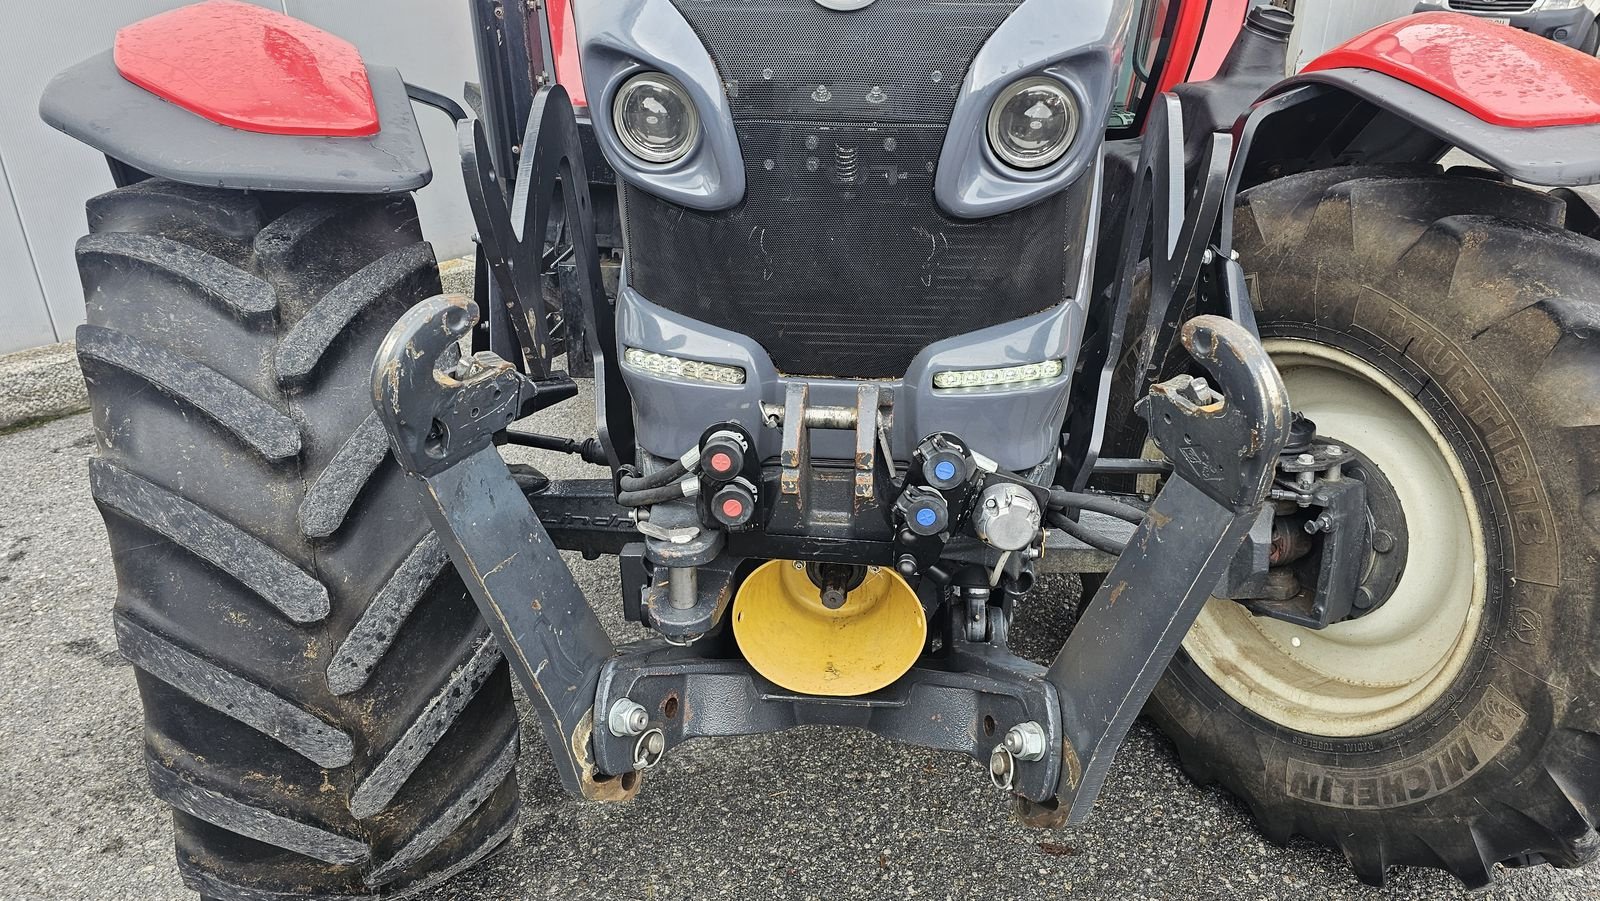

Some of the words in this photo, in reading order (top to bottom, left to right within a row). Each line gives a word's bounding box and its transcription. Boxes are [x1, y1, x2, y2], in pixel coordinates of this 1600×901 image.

[1381, 308, 1548, 545] MULTIBIB
[1292, 735, 1334, 752] TUBELESS
[1345, 740, 1375, 753] RADIAL
[1288, 736, 1480, 806] MICHELIN
